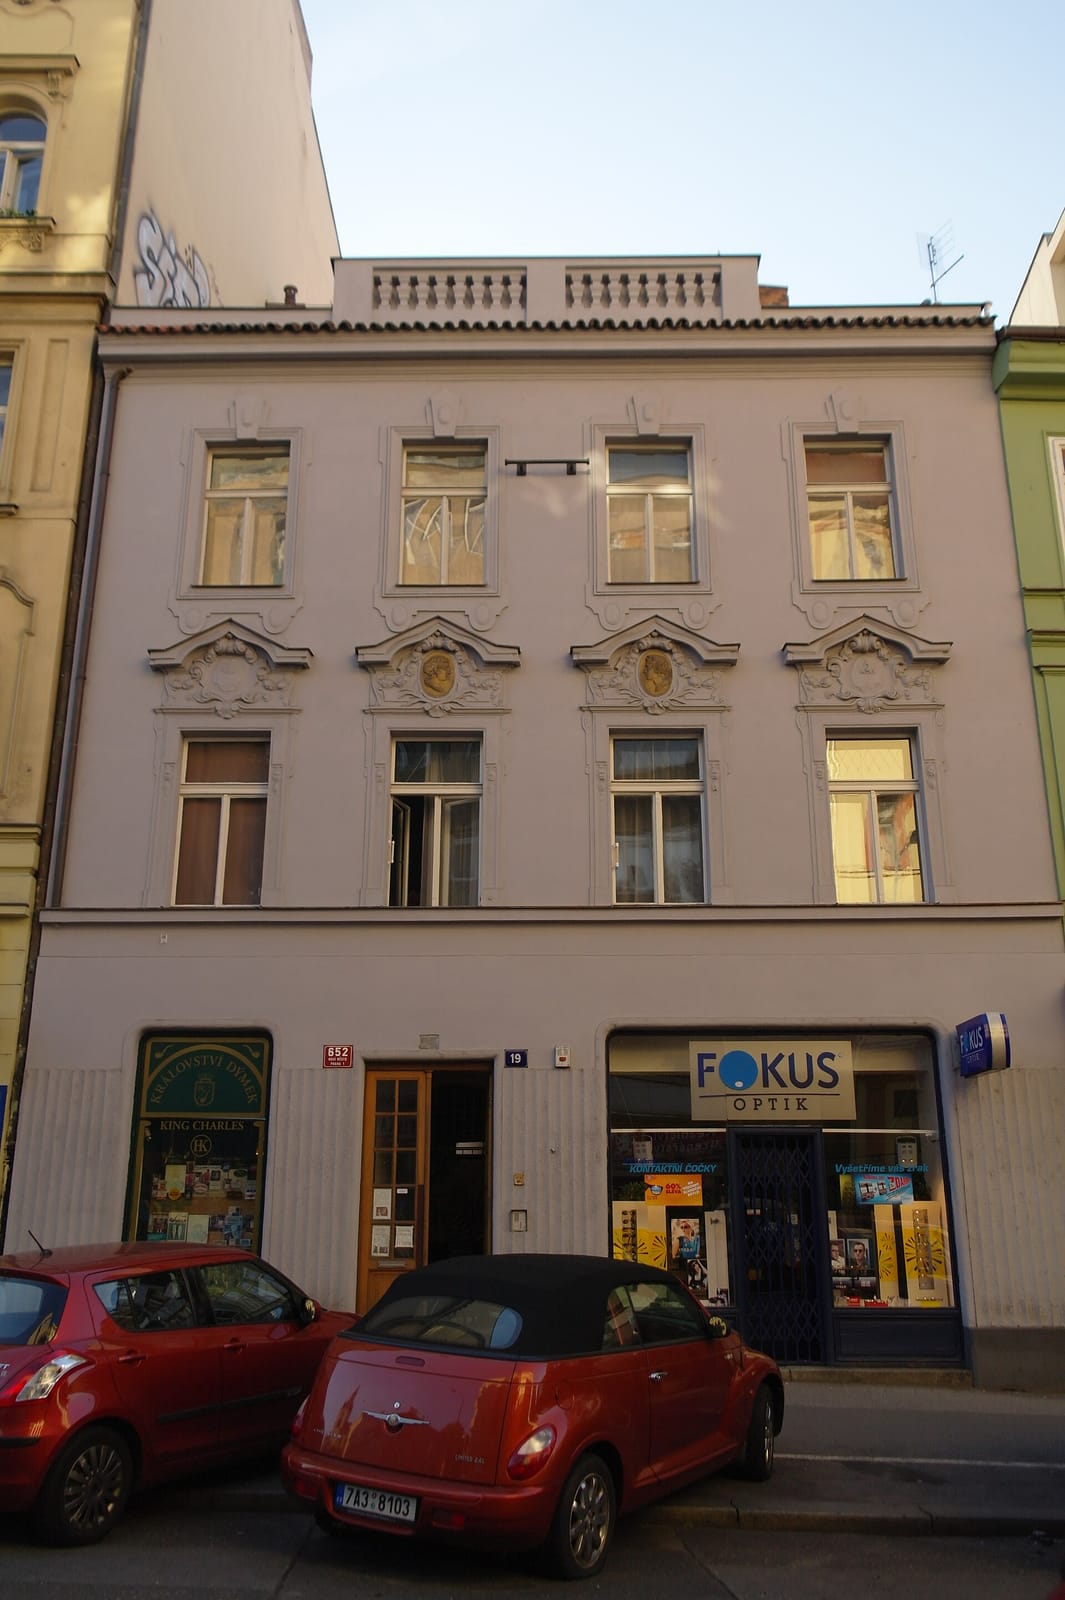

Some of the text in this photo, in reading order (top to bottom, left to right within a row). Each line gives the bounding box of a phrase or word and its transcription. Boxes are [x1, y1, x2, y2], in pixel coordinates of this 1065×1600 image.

[328, 1047, 349, 1057] 652
[510, 1053, 521, 1064] 19
[696, 1050, 839, 1091] FOKUS
[733, 1098, 808, 1111] OPTIK
[160, 1120, 245, 1131] KING CHARLES
[629, 1162, 717, 1173] KONTAKTNÍ ČOČKY
[346, 1487, 369, 1508] 7A3
[378, 1494, 410, 1517] 8103
